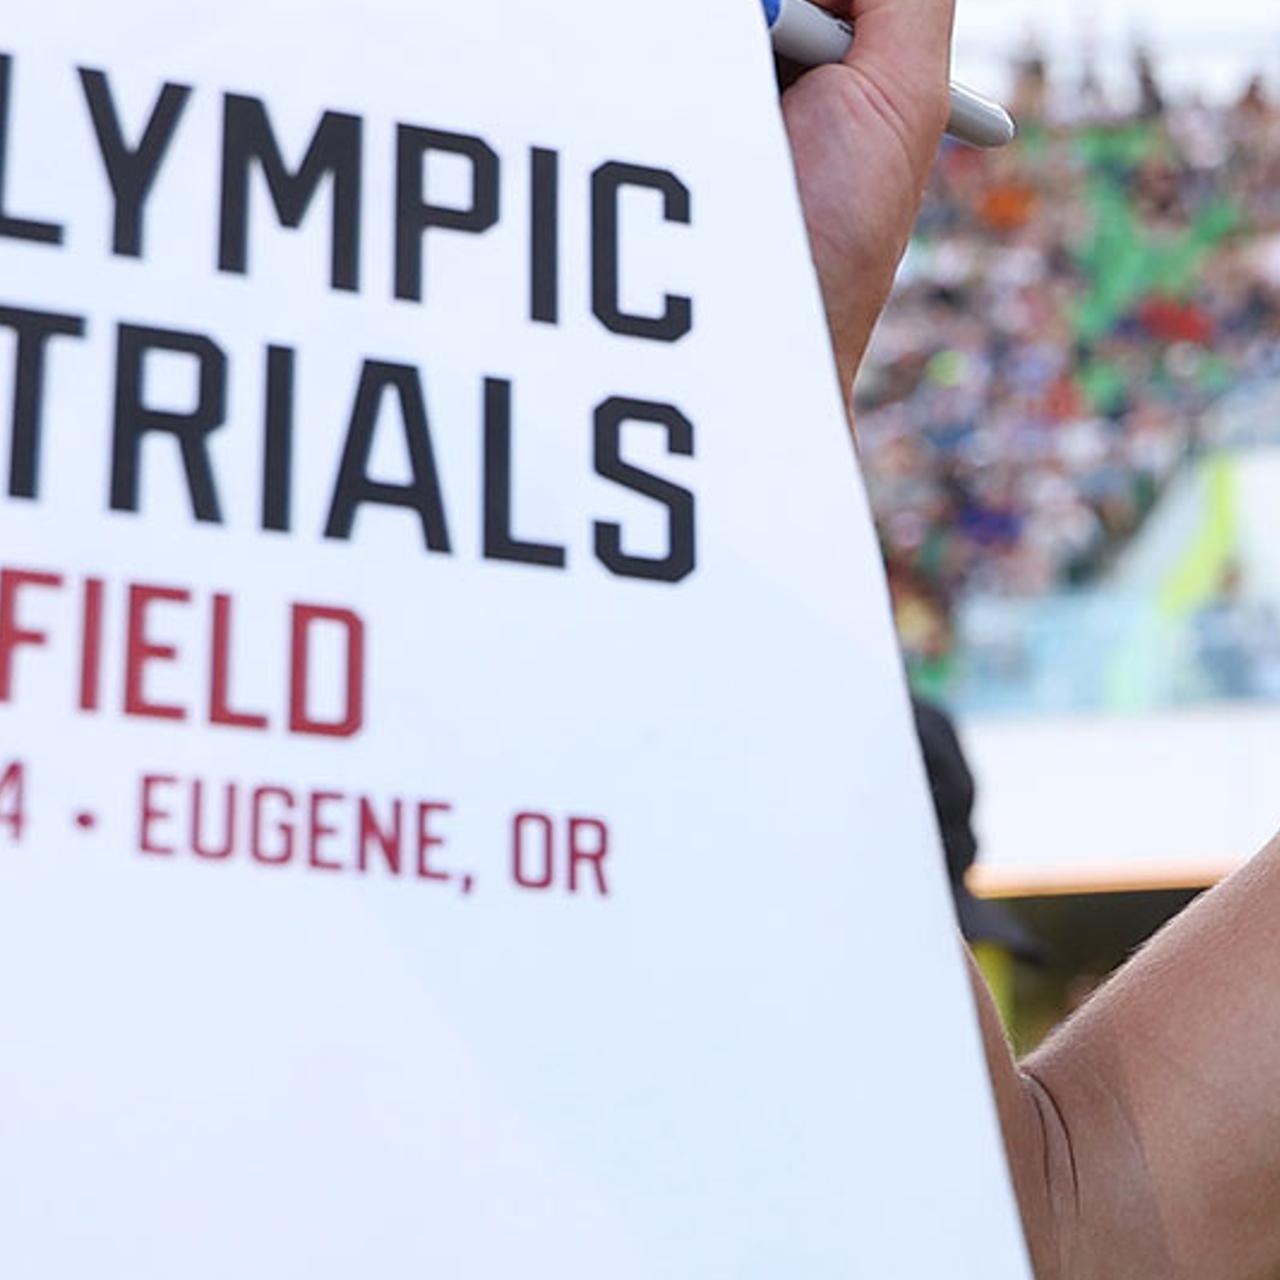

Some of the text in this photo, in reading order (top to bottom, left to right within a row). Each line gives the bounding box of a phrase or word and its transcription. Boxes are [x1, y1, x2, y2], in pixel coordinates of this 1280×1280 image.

[0, 305, 697, 584] TRIALS
[0, 568, 365, 740] FIELD
[137, 773, 477, 896] EUGENE,
[510, 810, 610, 897] OR
